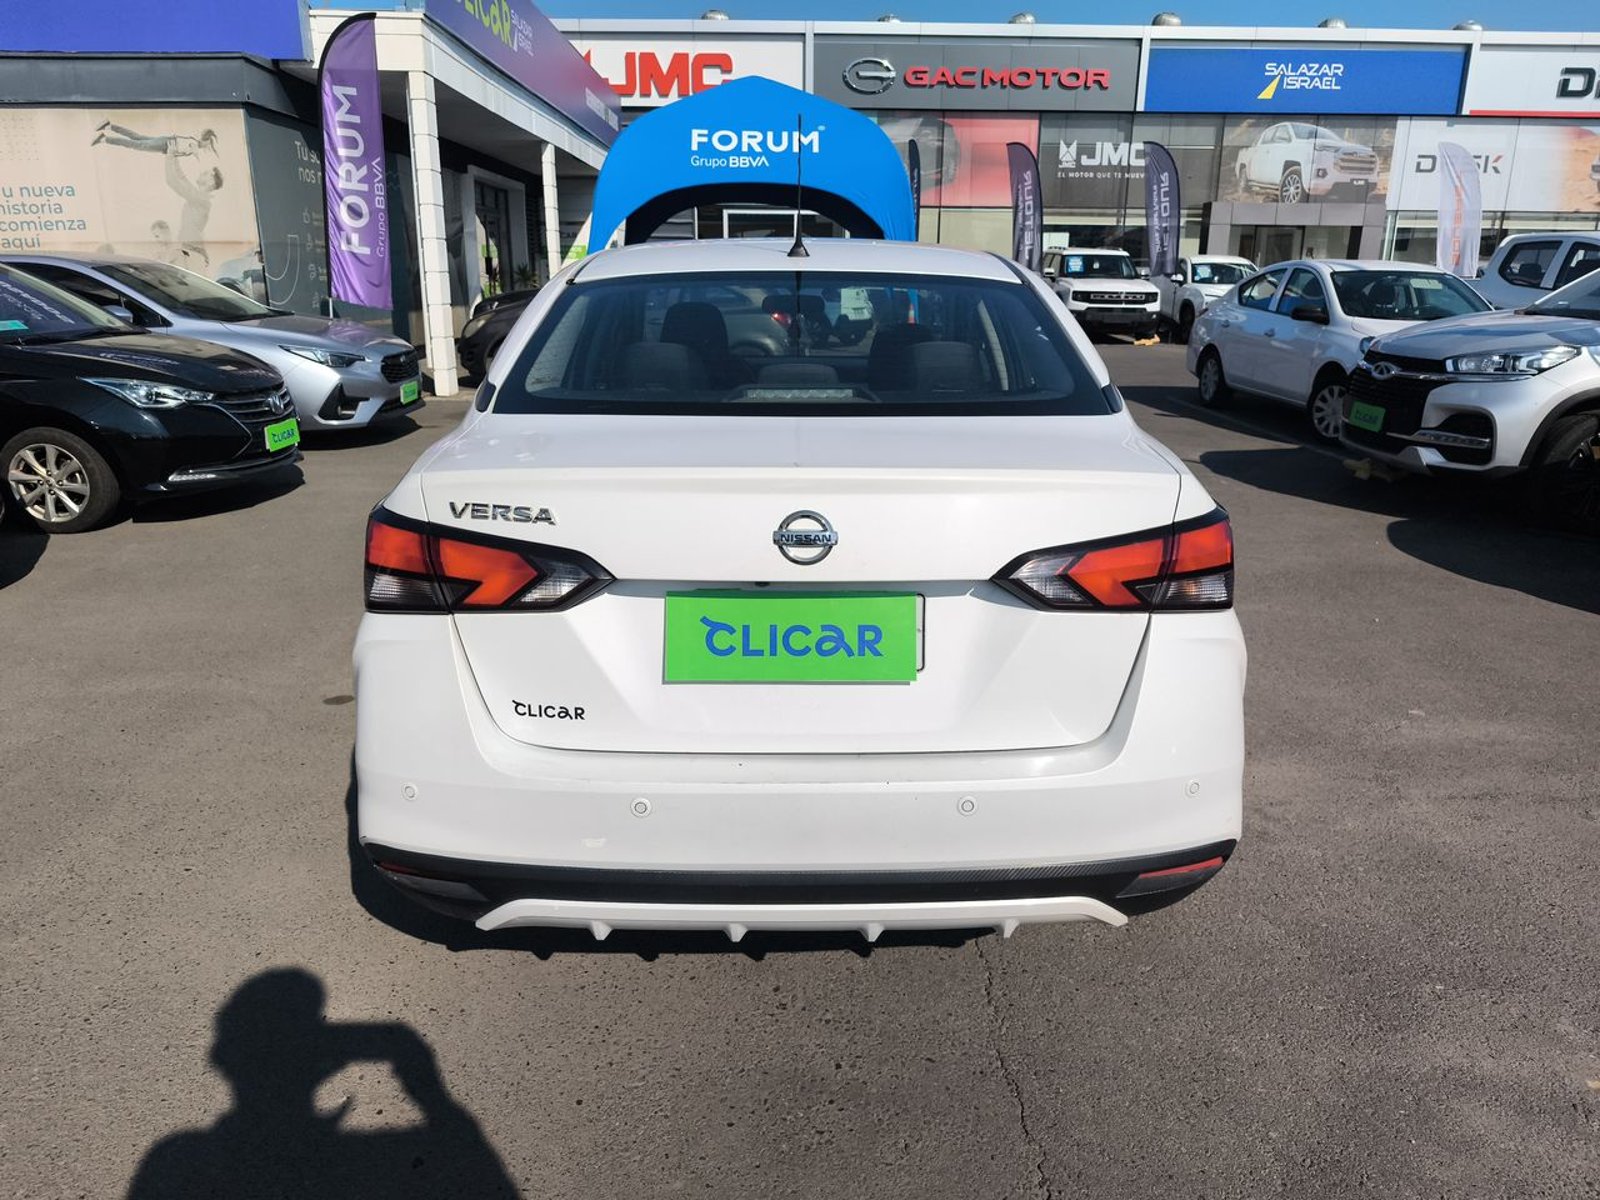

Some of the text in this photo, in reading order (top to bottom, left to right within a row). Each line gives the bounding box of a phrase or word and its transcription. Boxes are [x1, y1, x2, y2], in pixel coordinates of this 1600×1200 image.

[600, 52, 733, 98] JMC
[904, 66, 1111, 90] GAC MOTOR
[1264, 63, 1344, 76] SALAZAR
[1283, 77, 1341, 89] ISRAEL
[1556, 67, 1600, 98] D
[690, 129, 820, 153] FORUM
[690, 155, 769, 169] Grupo BBVA
[1081, 141, 1145, 166] JMC
[332, 85, 371, 255] FORUM
[20, 186, 75, 197] nueva
[371, 156, 387, 257] Grupo BBVA
[0, 216, 87, 231] comienza
[449, 501, 556, 526] VERSA
[780, 534, 832, 542] NISSAN
